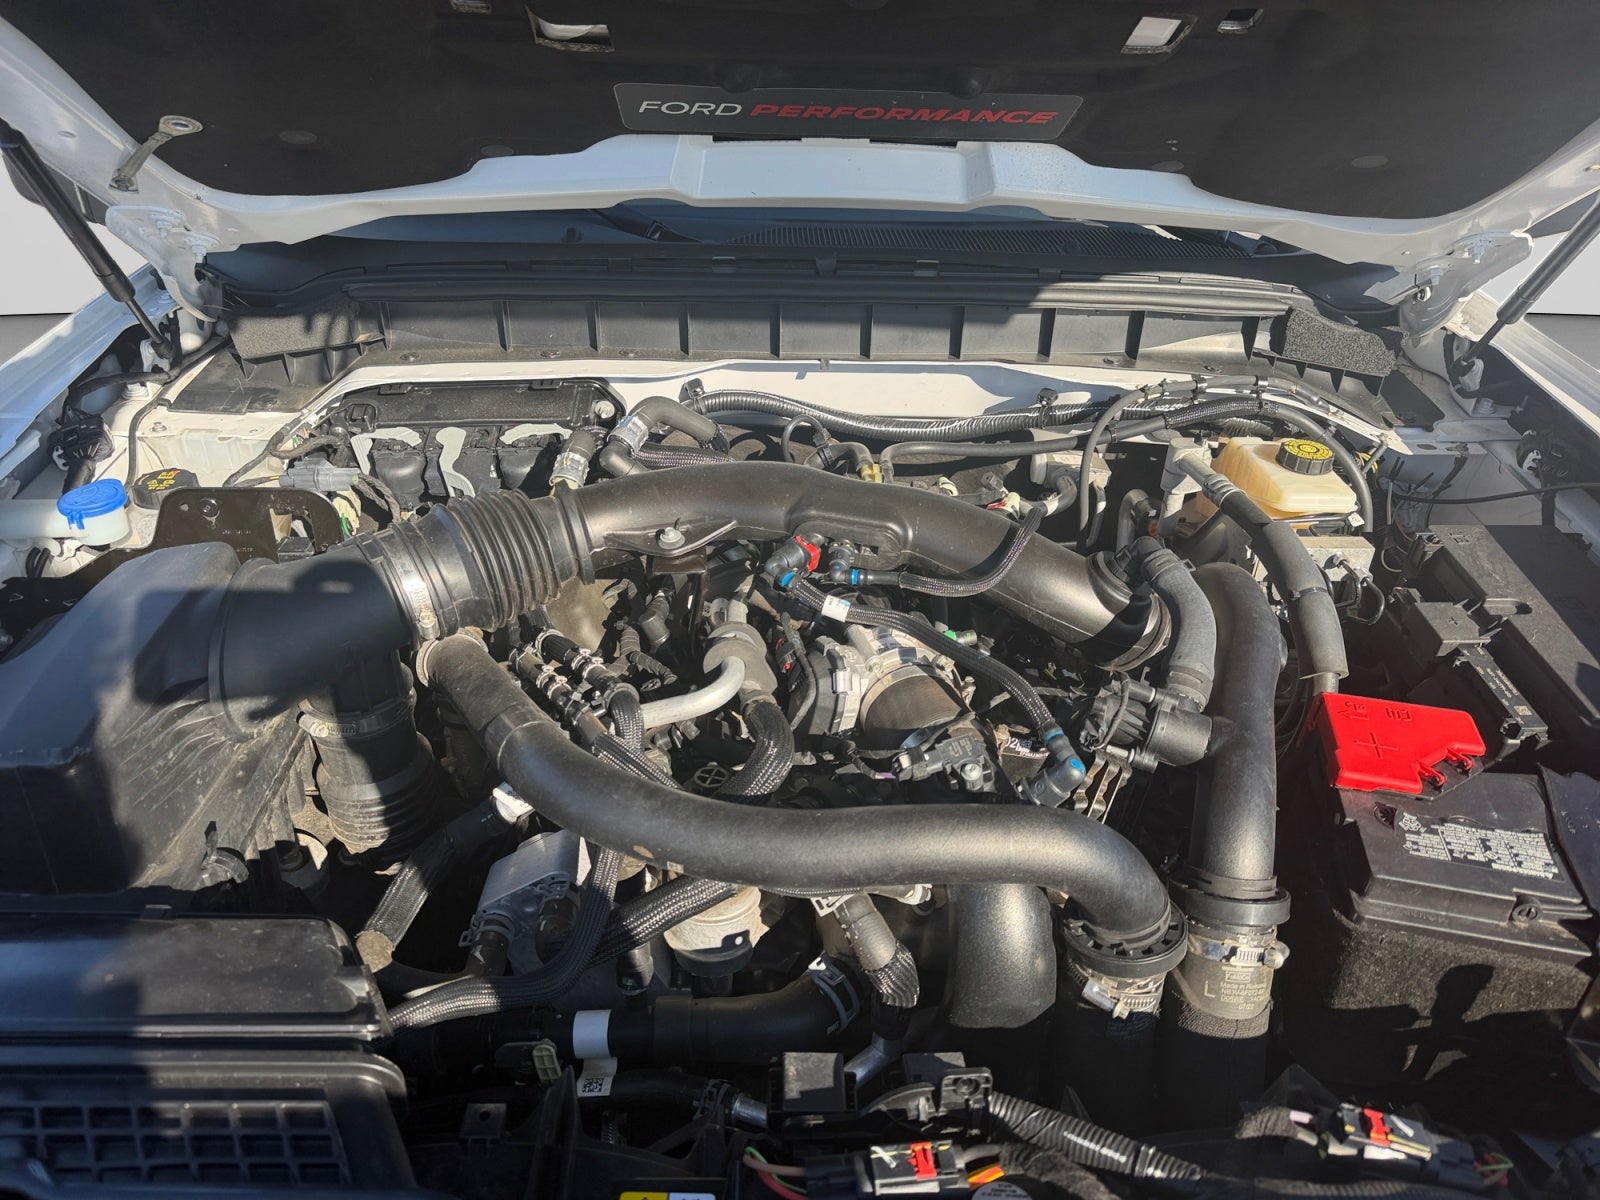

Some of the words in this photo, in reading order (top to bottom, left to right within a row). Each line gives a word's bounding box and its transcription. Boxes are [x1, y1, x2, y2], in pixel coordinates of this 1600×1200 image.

[638, 101, 743, 116] FORD
[750, 104, 1061, 124] PERFORMANCE
[1204, 980, 1216, 998] L
